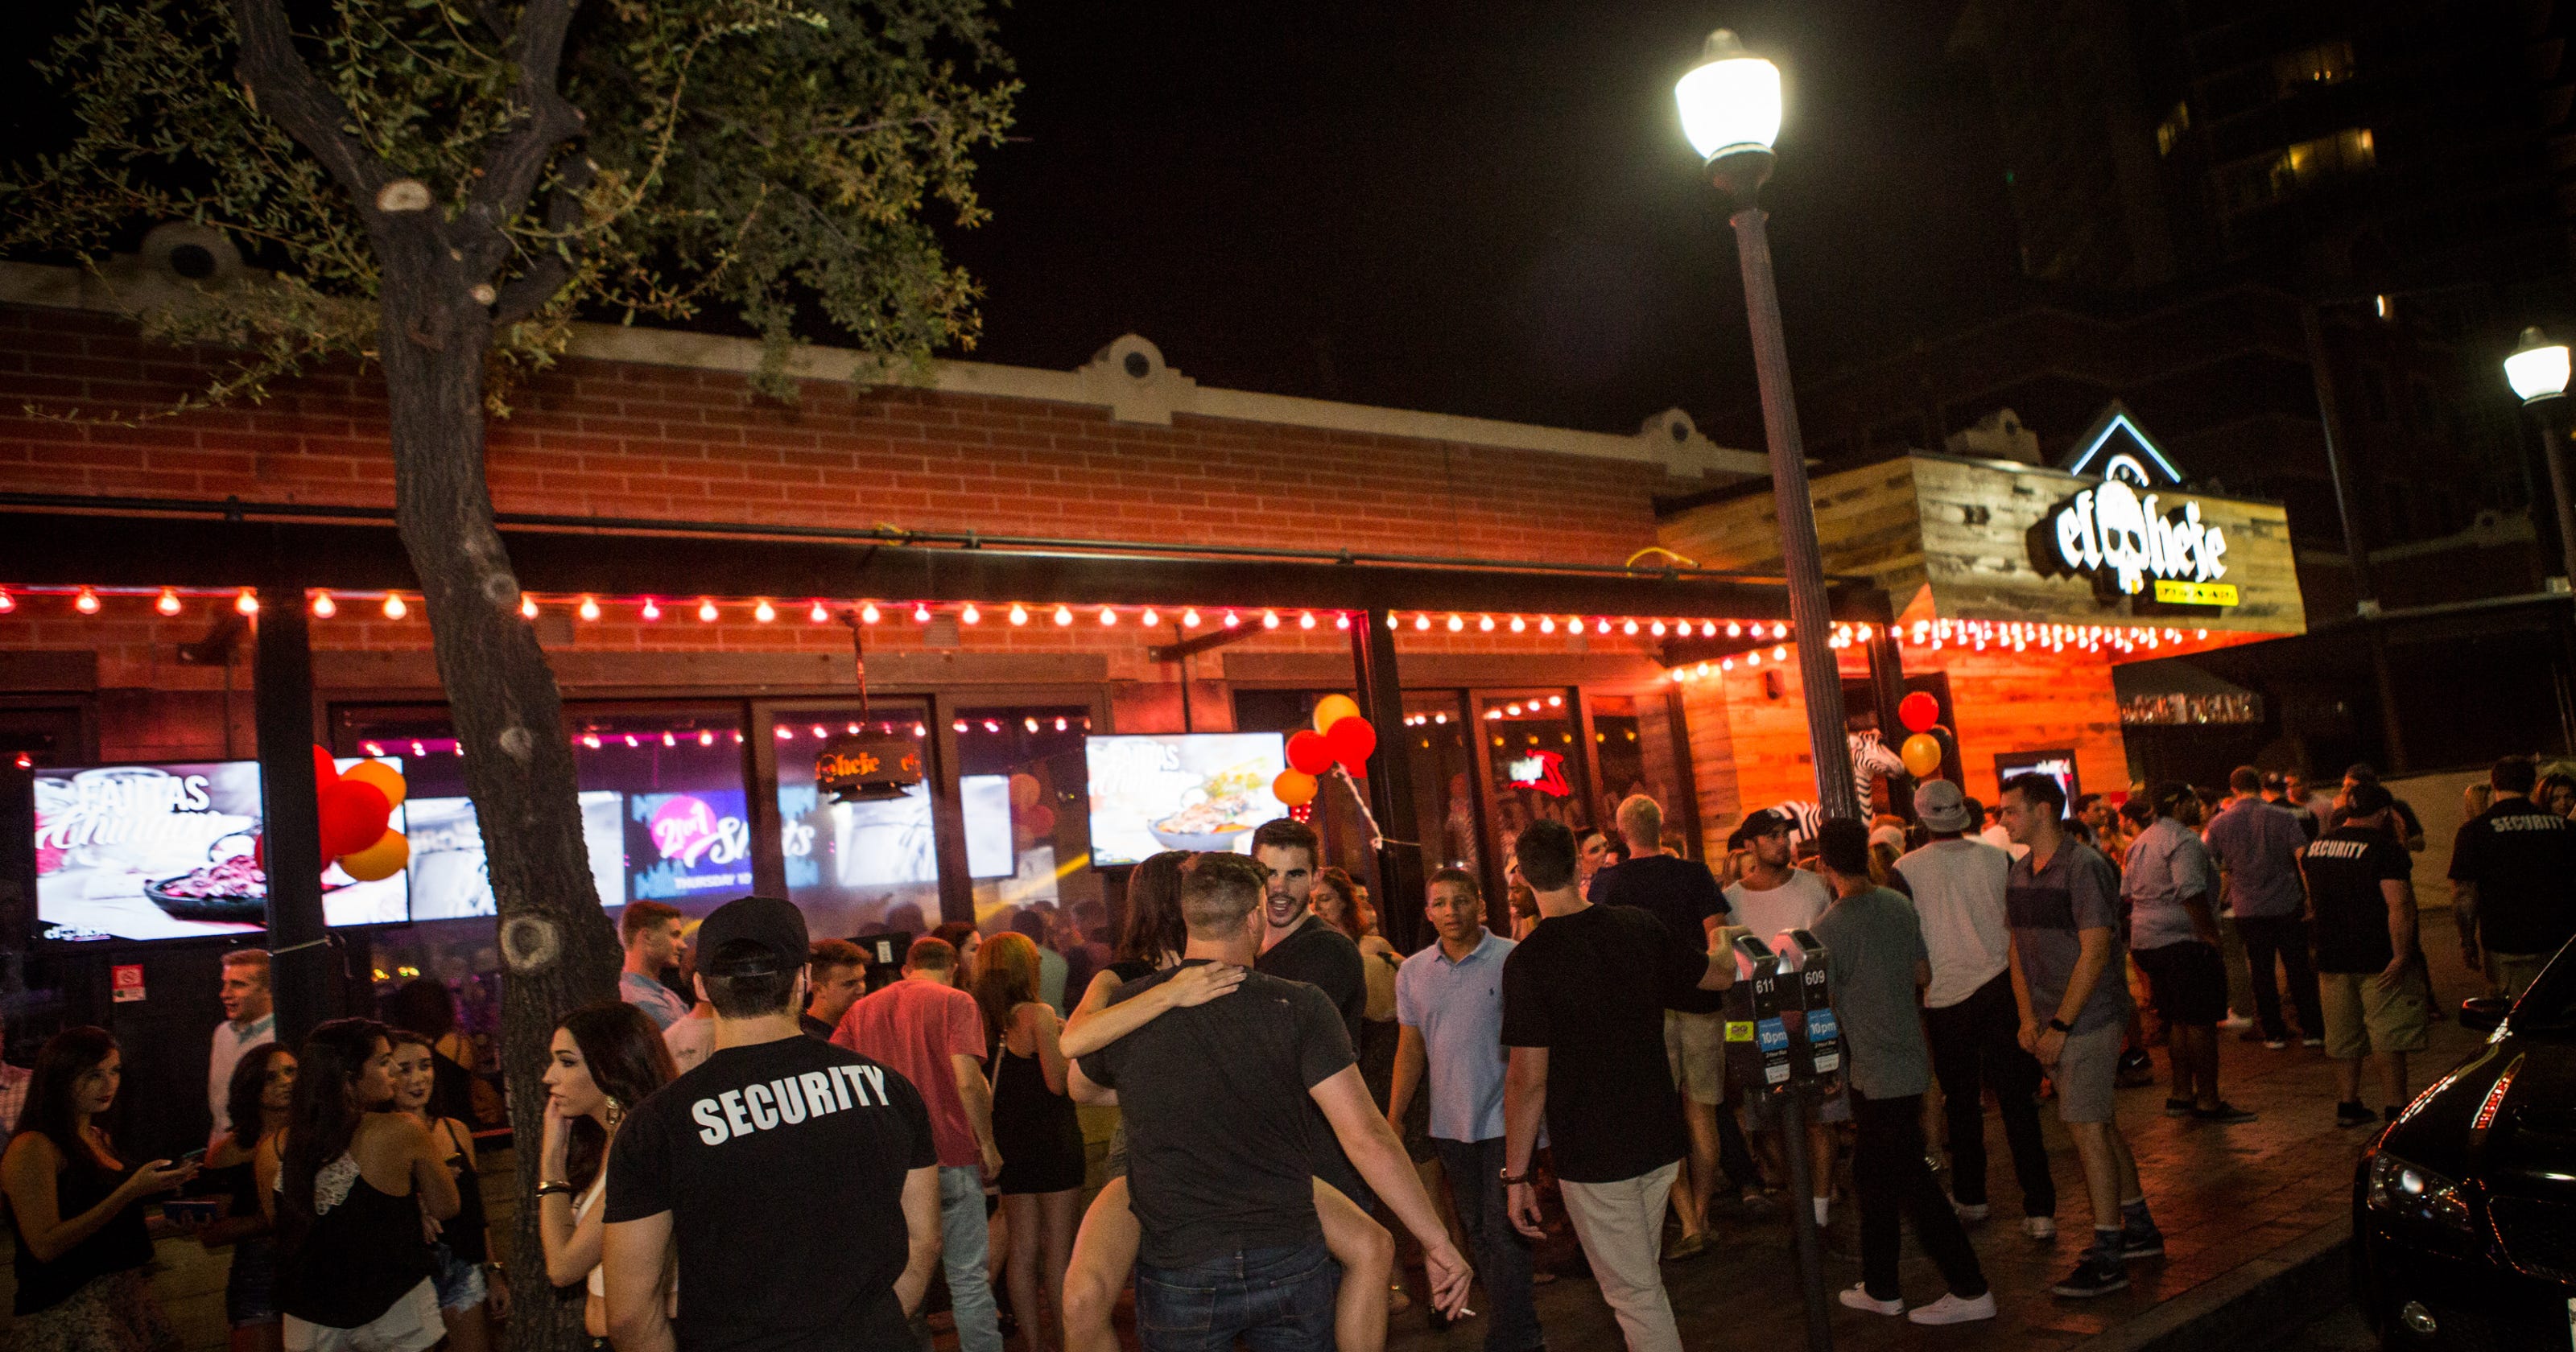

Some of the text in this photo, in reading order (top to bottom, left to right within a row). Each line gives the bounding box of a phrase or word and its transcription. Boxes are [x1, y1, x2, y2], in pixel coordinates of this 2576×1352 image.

[78, 775, 211, 815] FAJITAS
[2491, 814, 2566, 833] SECURITY
[2308, 839, 2368, 859] SECURITY
[1756, 977, 1775, 995] 611
[1805, 969, 1826, 986] 609
[1810, 1021, 1836, 1036] 10pm
[1761, 1031, 1788, 1045] 10pm
[691, 1065, 890, 1146] SECURITY
